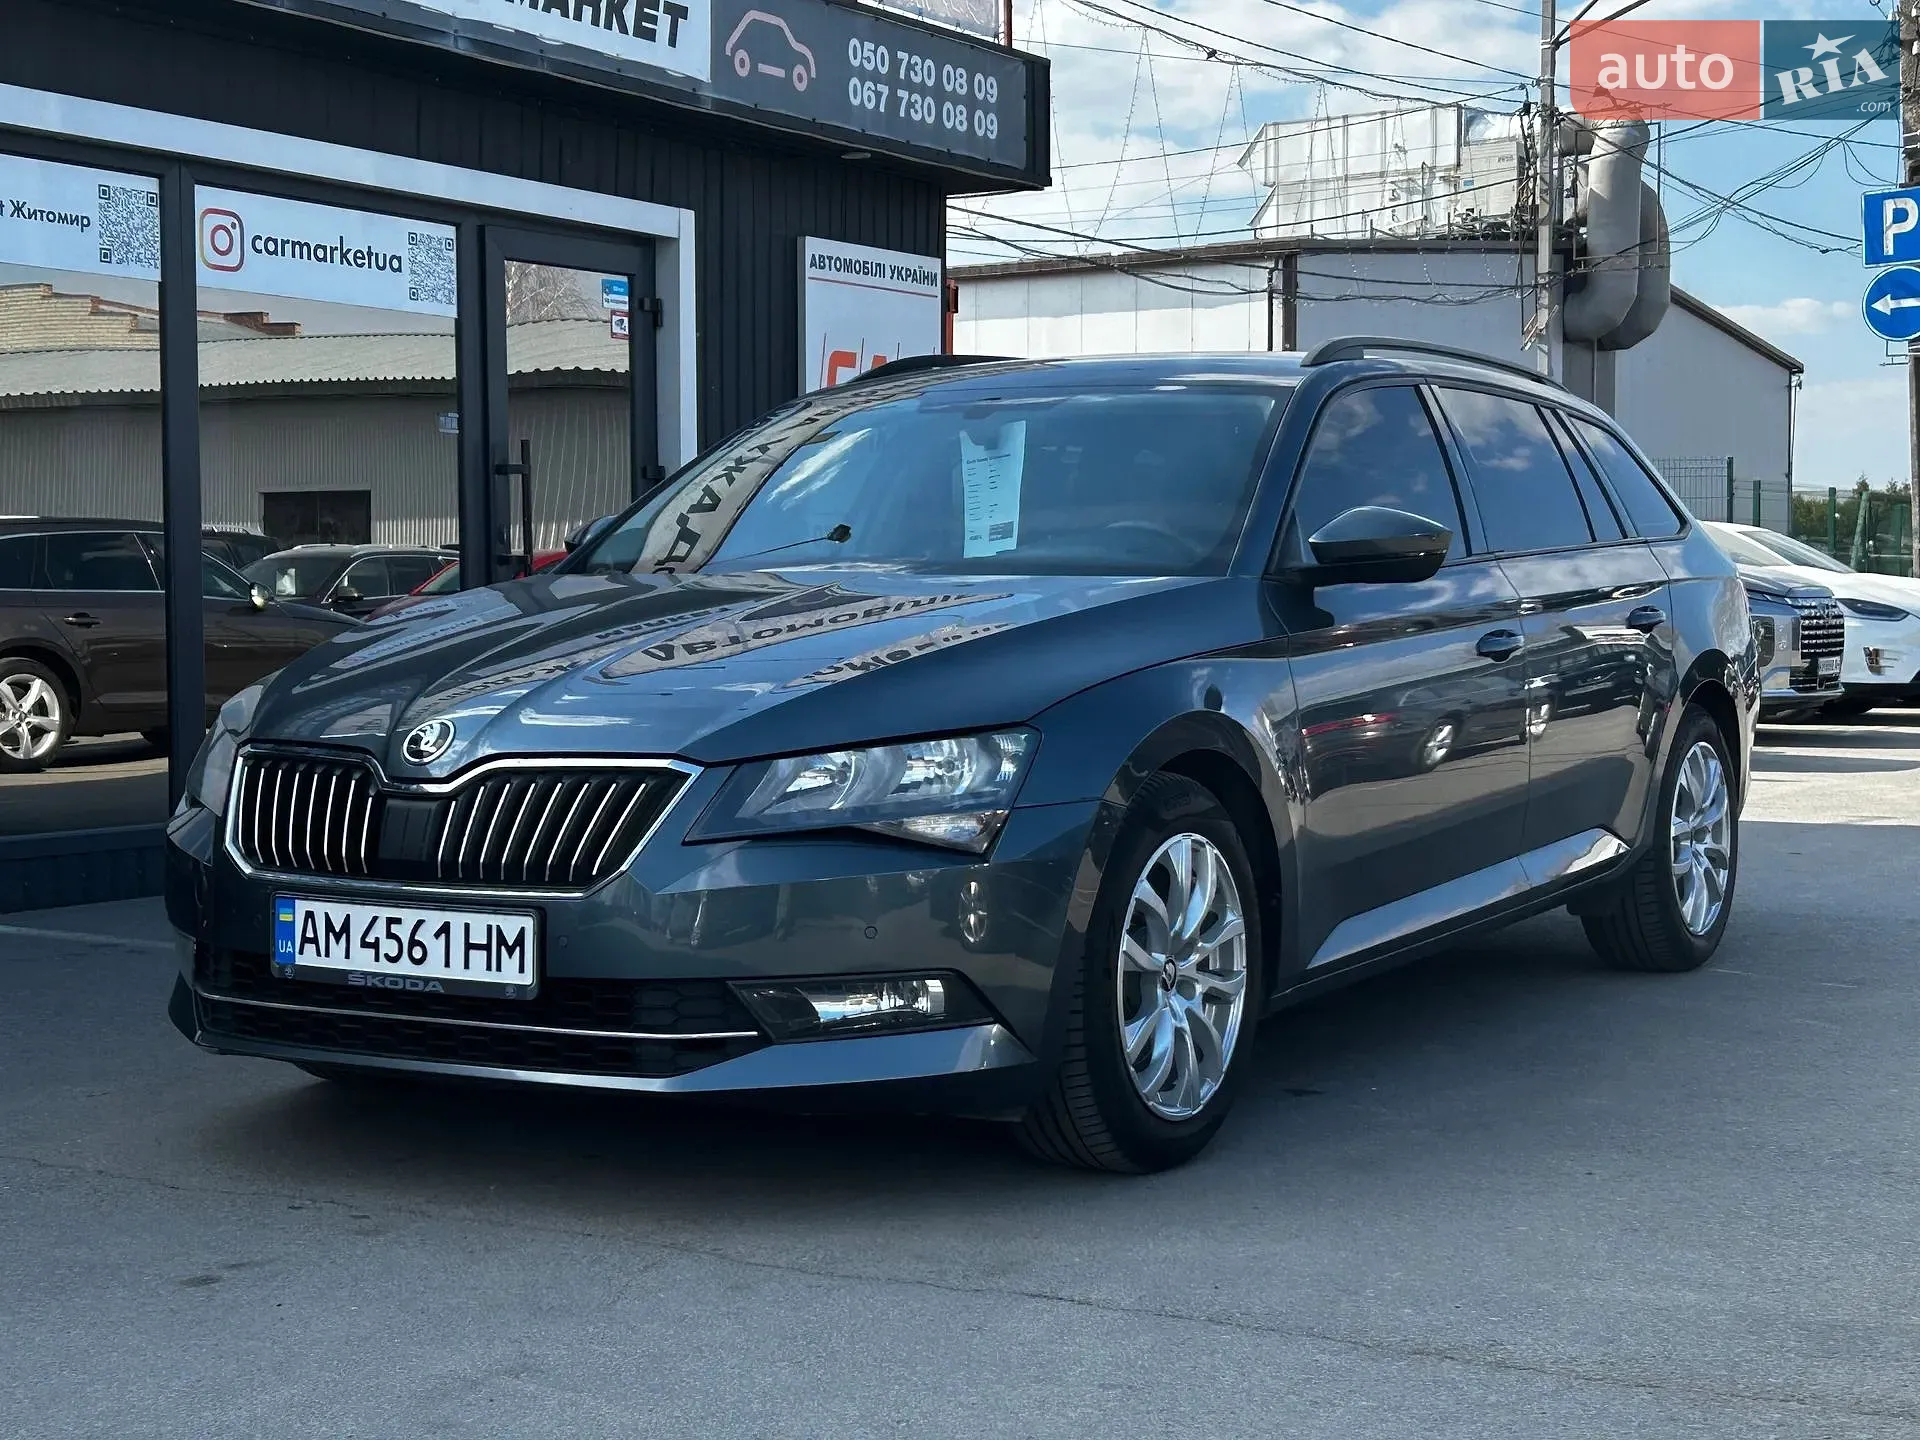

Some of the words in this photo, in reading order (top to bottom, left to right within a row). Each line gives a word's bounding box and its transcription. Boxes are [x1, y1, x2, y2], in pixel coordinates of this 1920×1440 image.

[848, 37, 890, 75] 050
[897, 50, 936, 87] 730
[942, 63, 968, 96] 08
[973, 72, 998, 104] 09
[848, 76, 890, 113] 067
[897, 89, 936, 124] 730
[942, 101, 968, 132] 08
[973, 109, 998, 140] 09
[8, 199, 91, 233] Житомир
[1883, 197, 1919, 256] P
[251, 234, 403, 273] carmarketua
[809, 253, 886, 279] АВТОМОБІЛІ
[889, 264, 938, 288] УКРАЇНИ
[278, 939, 294, 954] UA
[298, 910, 351, 960] AM
[359, 915, 451, 969] 4561
[463, 922, 526, 974] HM
[347, 972, 445, 993] ŠKODA
